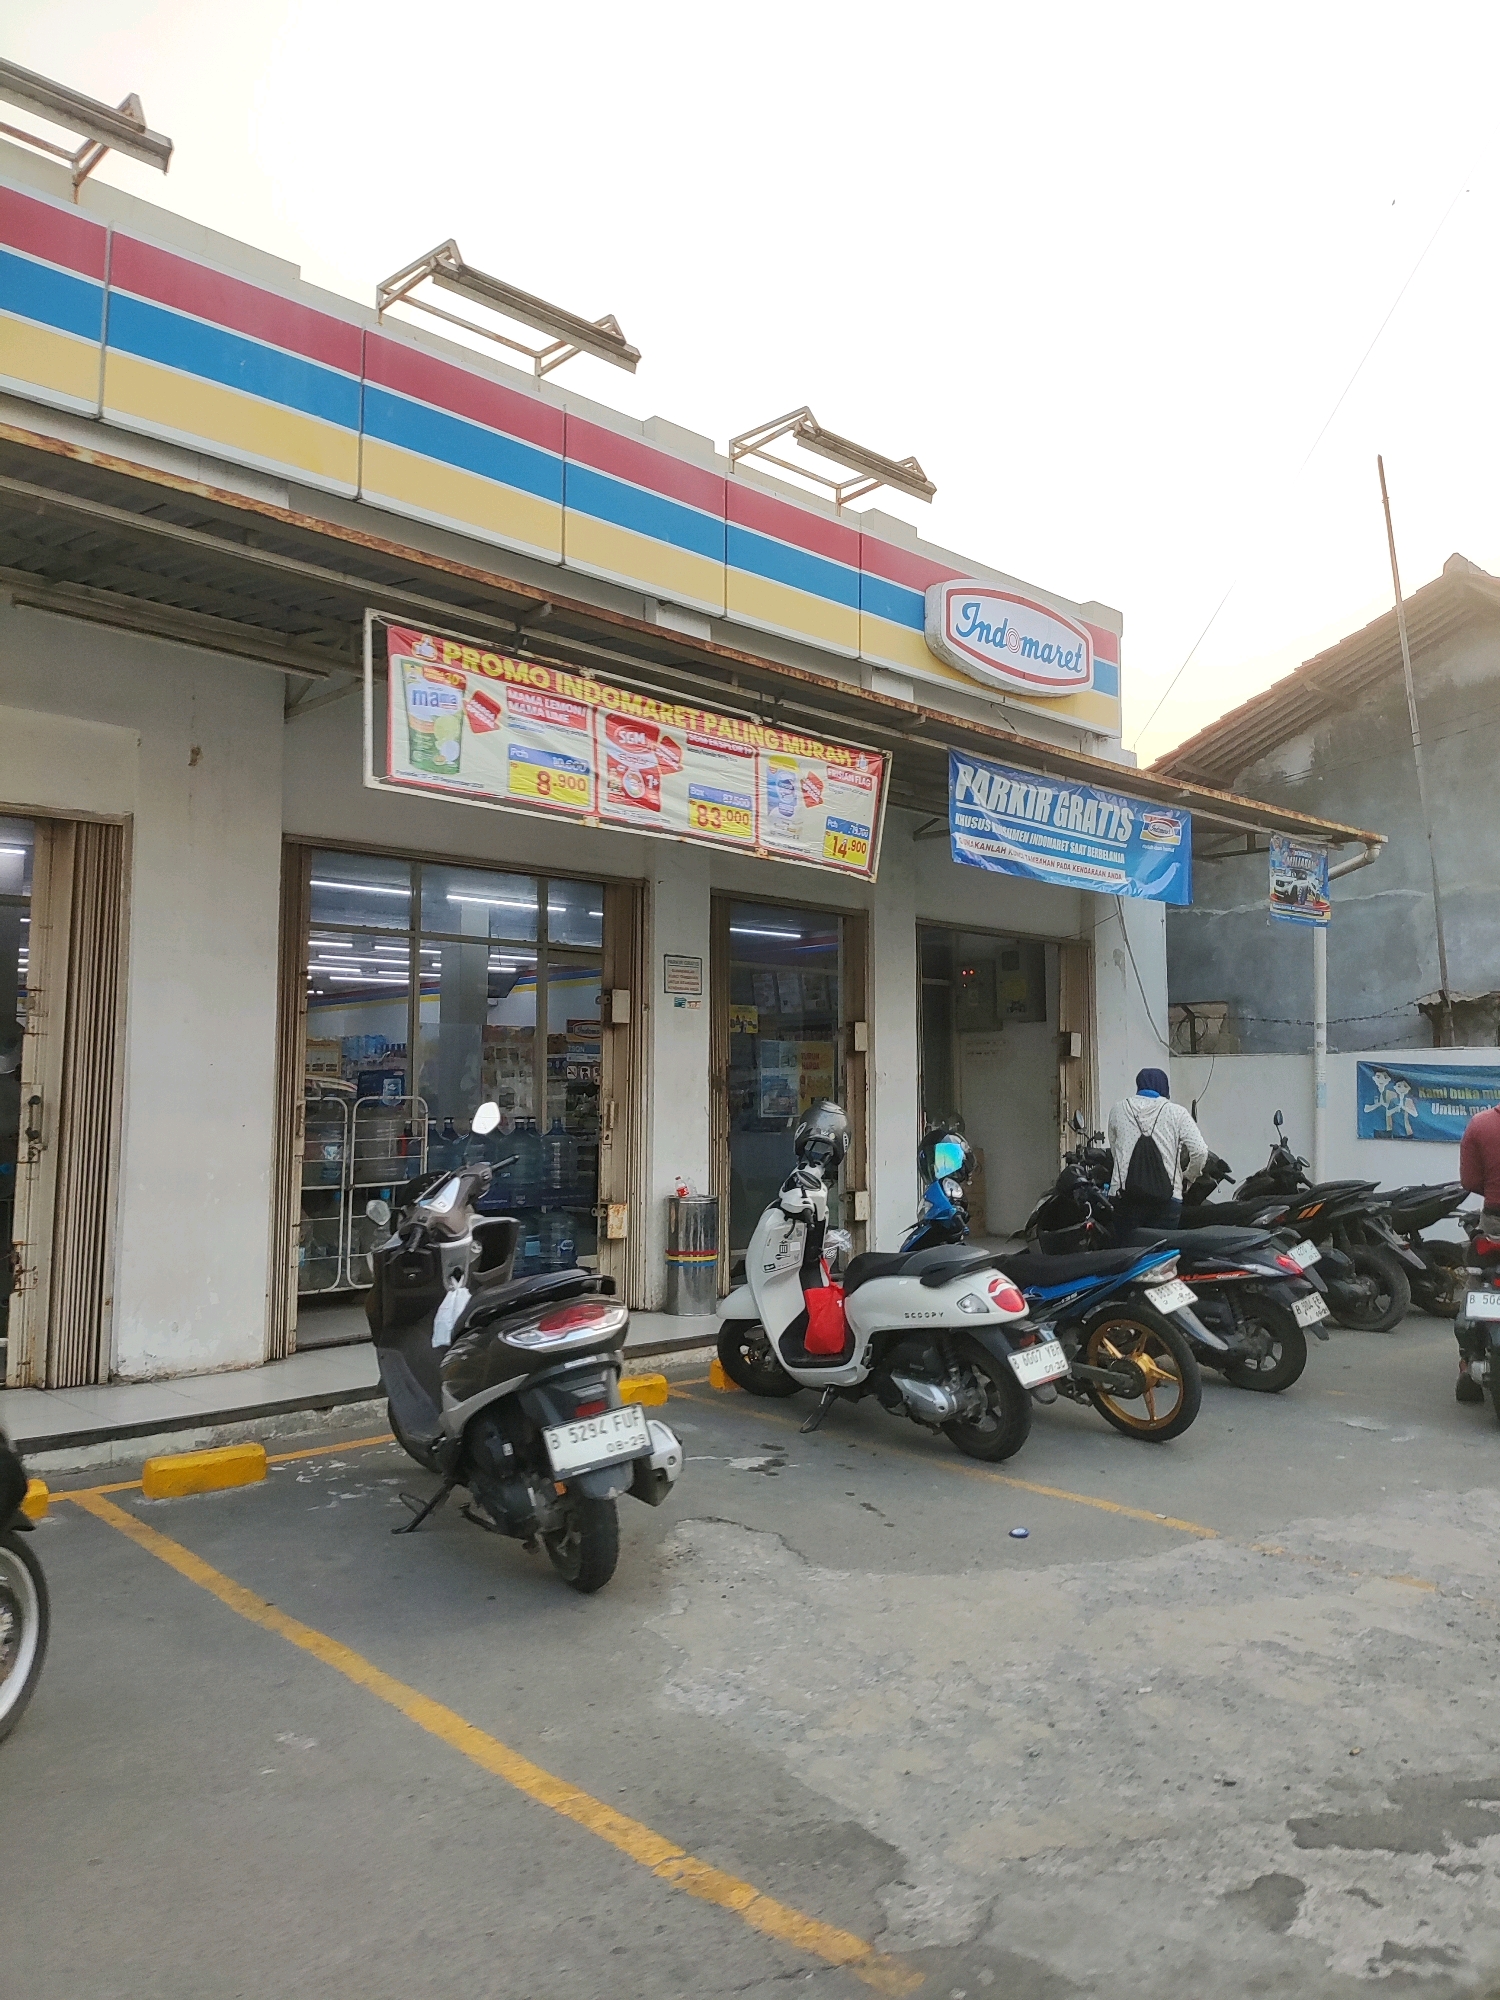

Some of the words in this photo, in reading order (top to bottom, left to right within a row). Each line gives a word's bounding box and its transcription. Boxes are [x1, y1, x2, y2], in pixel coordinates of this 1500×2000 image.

[956, 602, 1083, 673] Indomaret
[442, 640, 551, 688] PROMO
[556, 672, 700, 732] INDOMARET
[703, 710, 779, 750] PALING
[782, 733, 852, 767] MURAH
[507, 690, 543, 706] MAMA
[508, 701, 546, 717] MAMA
[619, 731, 646, 745] SGM
[536, 770, 587, 796] 8.900
[827, 769, 855, 784] FRISIAN
[854, 776, 872, 787] FLAG
[955, 762, 1054, 823] PARKIR
[1053, 790, 1135, 842] GRATIS
[696, 803, 750, 829] 83.000
[833, 835, 867, 858] 14.900
[955, 812, 991, 832] KHUSUS
[1028, 832, 1070, 852] INDOMARET
[1069, 841, 1089, 856] SAAT
[1087, 846, 1125, 864] BERBELANJA
[1056, 861, 1072, 871] PADA
[1072, 863, 1106, 878] KENDARAAN
[1107, 872, 1122, 880] ANDA
[1418, 1087, 1448, 1099] Kami
[1449, 1086, 1480, 1100] buka
[1431, 1102, 1467, 1116] Untuk
[1469, 1294, 1476, 1304] B
[568, 1422, 608, 1444] 5294
[613, 1410, 642, 1431] FUF
